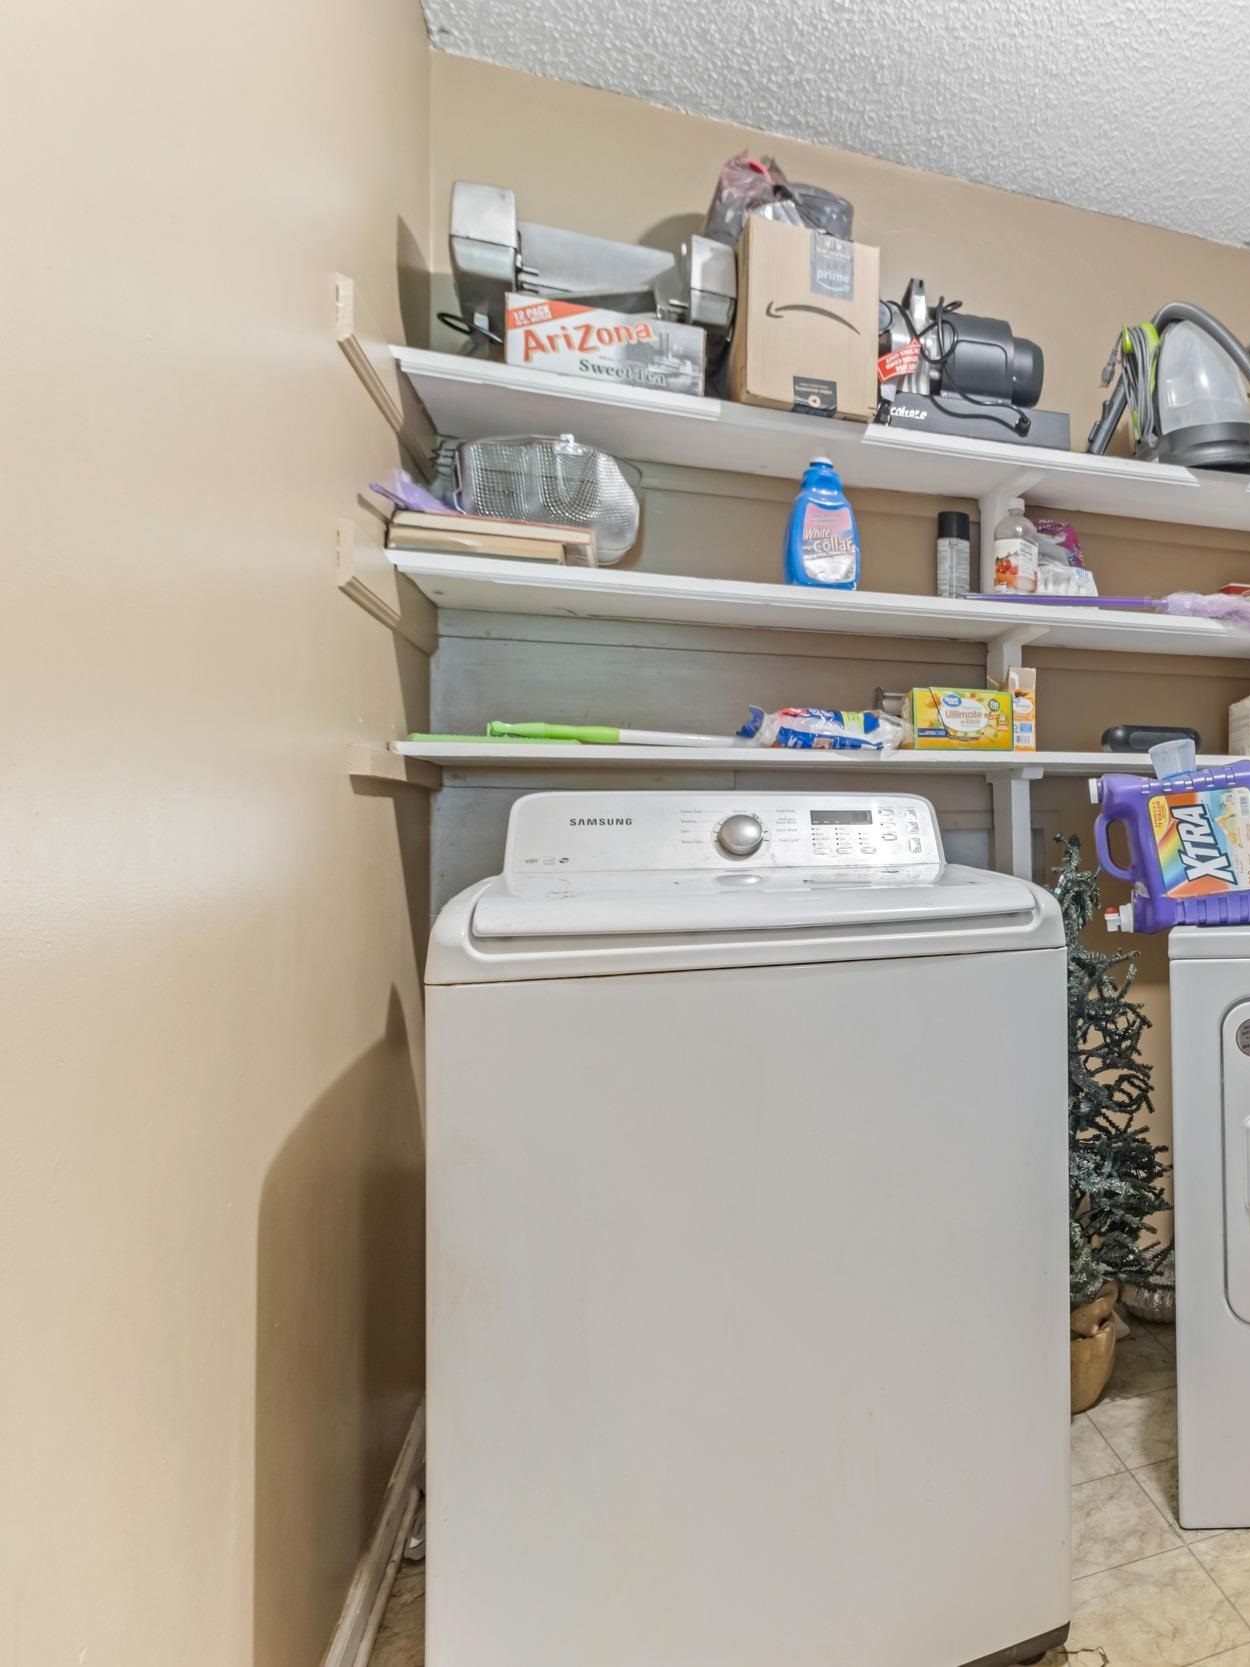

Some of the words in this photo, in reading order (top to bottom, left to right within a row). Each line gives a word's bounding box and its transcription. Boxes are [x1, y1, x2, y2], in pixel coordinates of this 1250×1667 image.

[816, 269, 849, 281] prime
[524, 322, 655, 362] AriZona
[579, 359, 631, 379] Sweet
[637, 370, 667, 386] Tea
[805, 527, 832, 540] White
[813, 536, 853, 553] collar
[945, 710, 983, 719] Ultimate
[569, 818, 633, 826] SAMSUNG
[1170, 804, 1238, 886] XTRA
